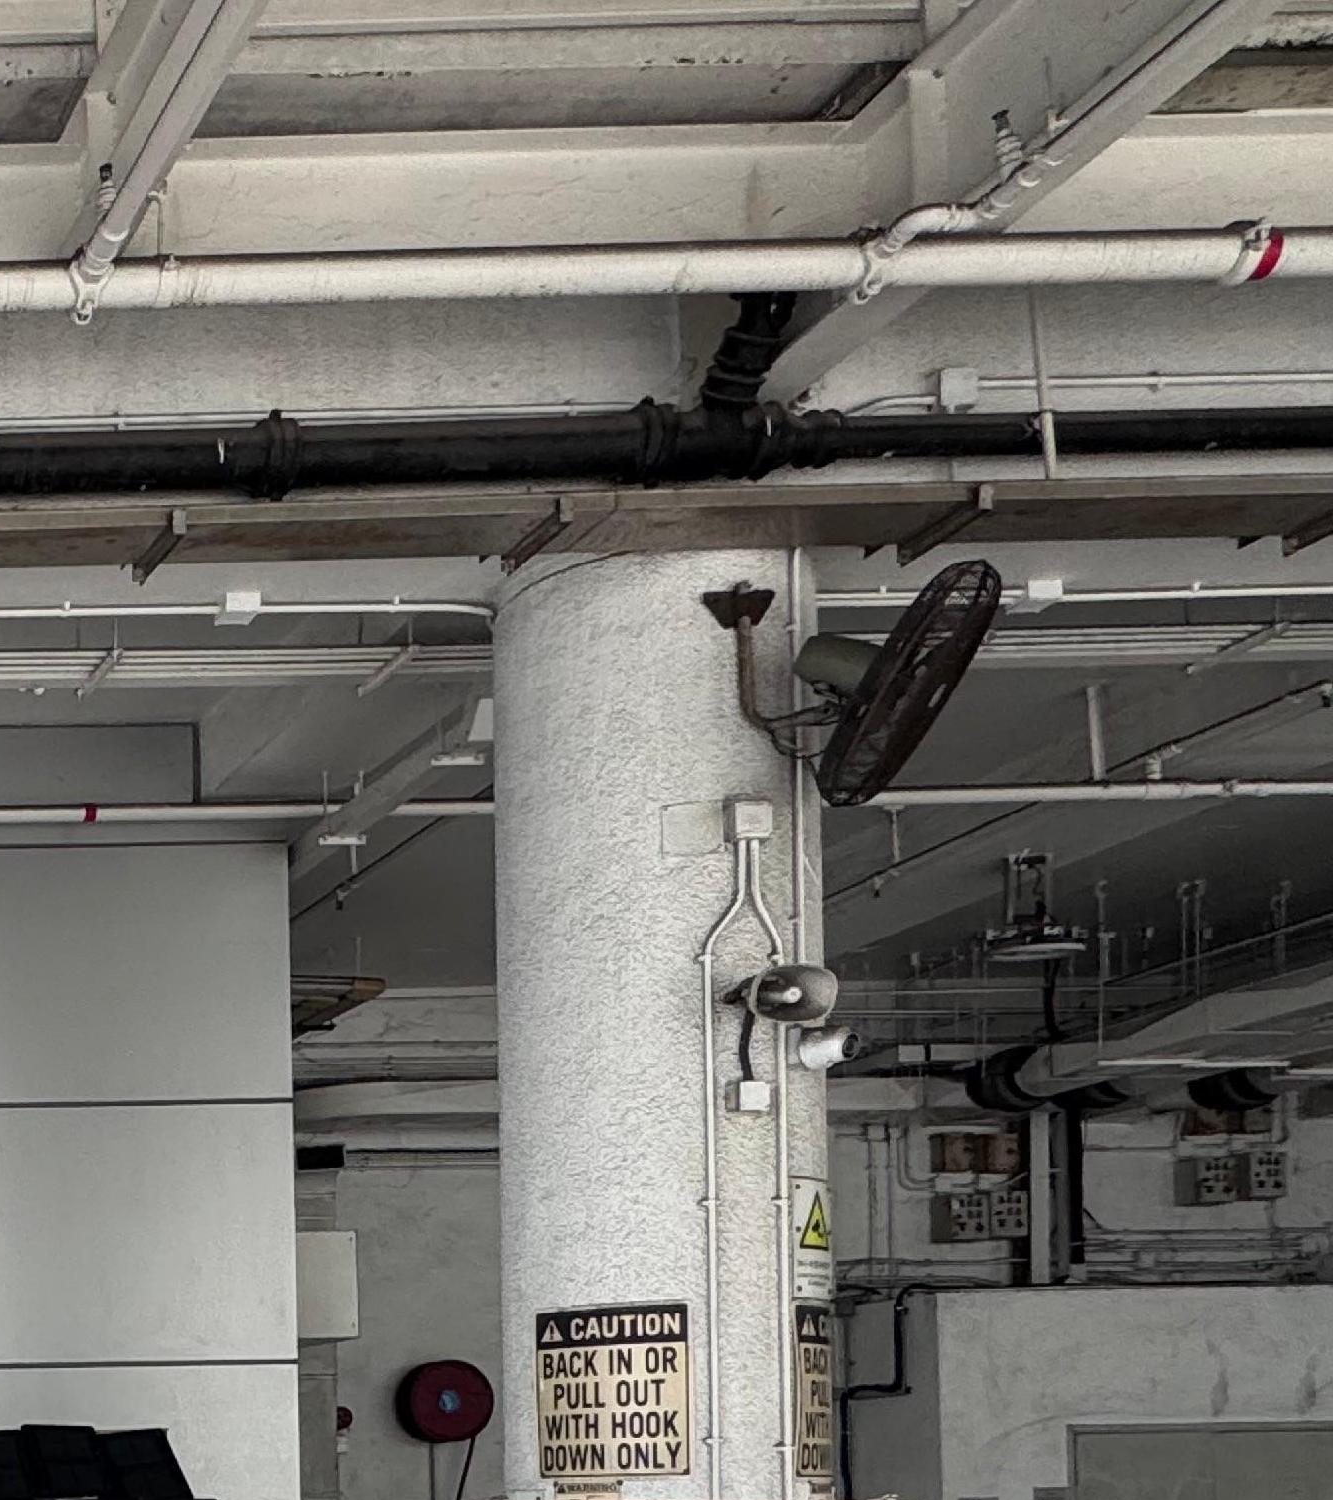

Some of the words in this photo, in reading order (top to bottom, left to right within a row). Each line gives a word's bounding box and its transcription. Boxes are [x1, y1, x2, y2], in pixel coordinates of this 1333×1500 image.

[569, 1312, 681, 1340] CAUTION
[542, 1350, 598, 1380] BACK
[608, 1348, 633, 1375] IN
[644, 1346, 678, 1374] OR
[552, 1381, 605, 1410] PULL
[615, 1378, 666, 1407] OUT
[545, 1412, 600, 1441] WITH
[611, 1410, 679, 1438] HOOK
[543, 1444, 605, 1472] DOWN
[617, 1441, 682, 1470] ONLY
